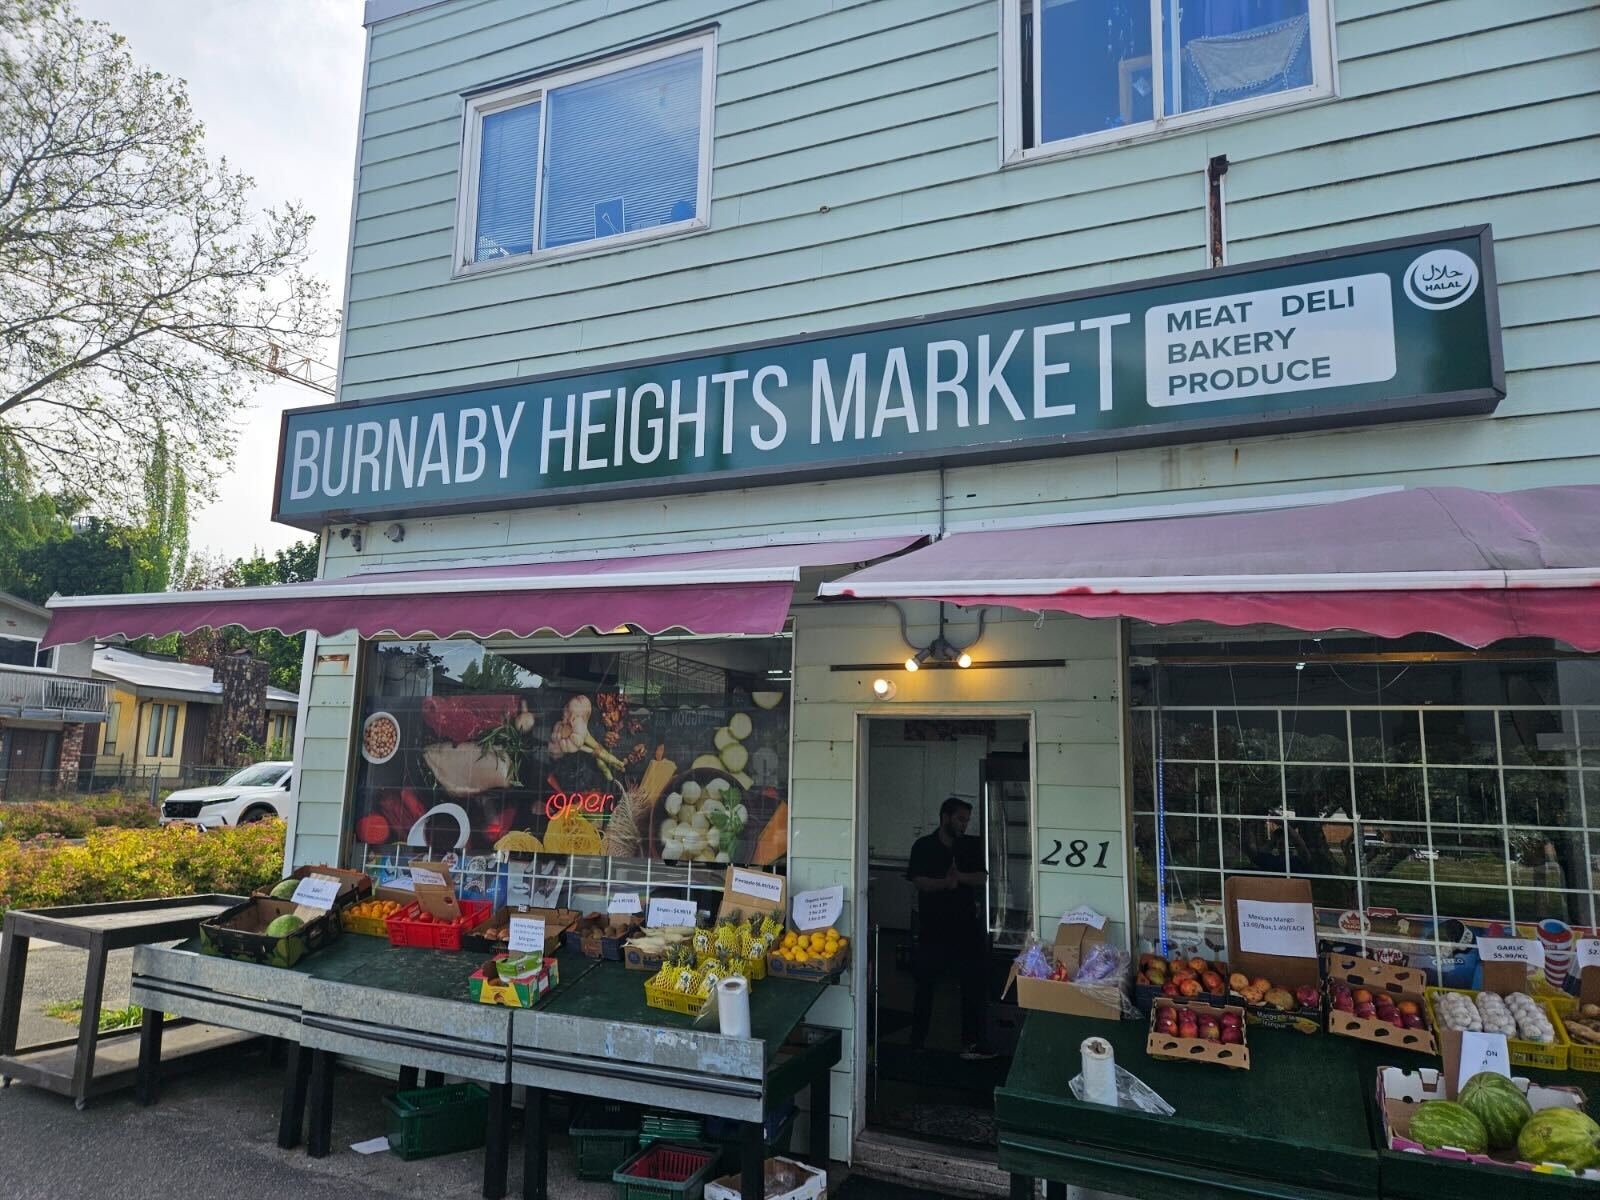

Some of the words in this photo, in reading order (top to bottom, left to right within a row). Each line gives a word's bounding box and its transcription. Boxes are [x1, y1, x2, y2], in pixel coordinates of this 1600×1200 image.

[1422, 264, 1463, 281] حلال
[1425, 281, 1462, 292] HALAL
[1166, 300, 1254, 334] MEAT
[1281, 285, 1356, 317] DELI
[1167, 327, 1297, 365] BAKERY
[1167, 355, 1333, 397] PRODUCE
[290, 401, 525, 501] BURNABY
[539, 364, 789, 475] HEIGHTS
[810, 312, 1131, 445] MARKET
[1039, 839, 1110, 869] 281
[1247, 913, 1273, 923] Mexican
[1273, 916, 1295, 924] Mango
